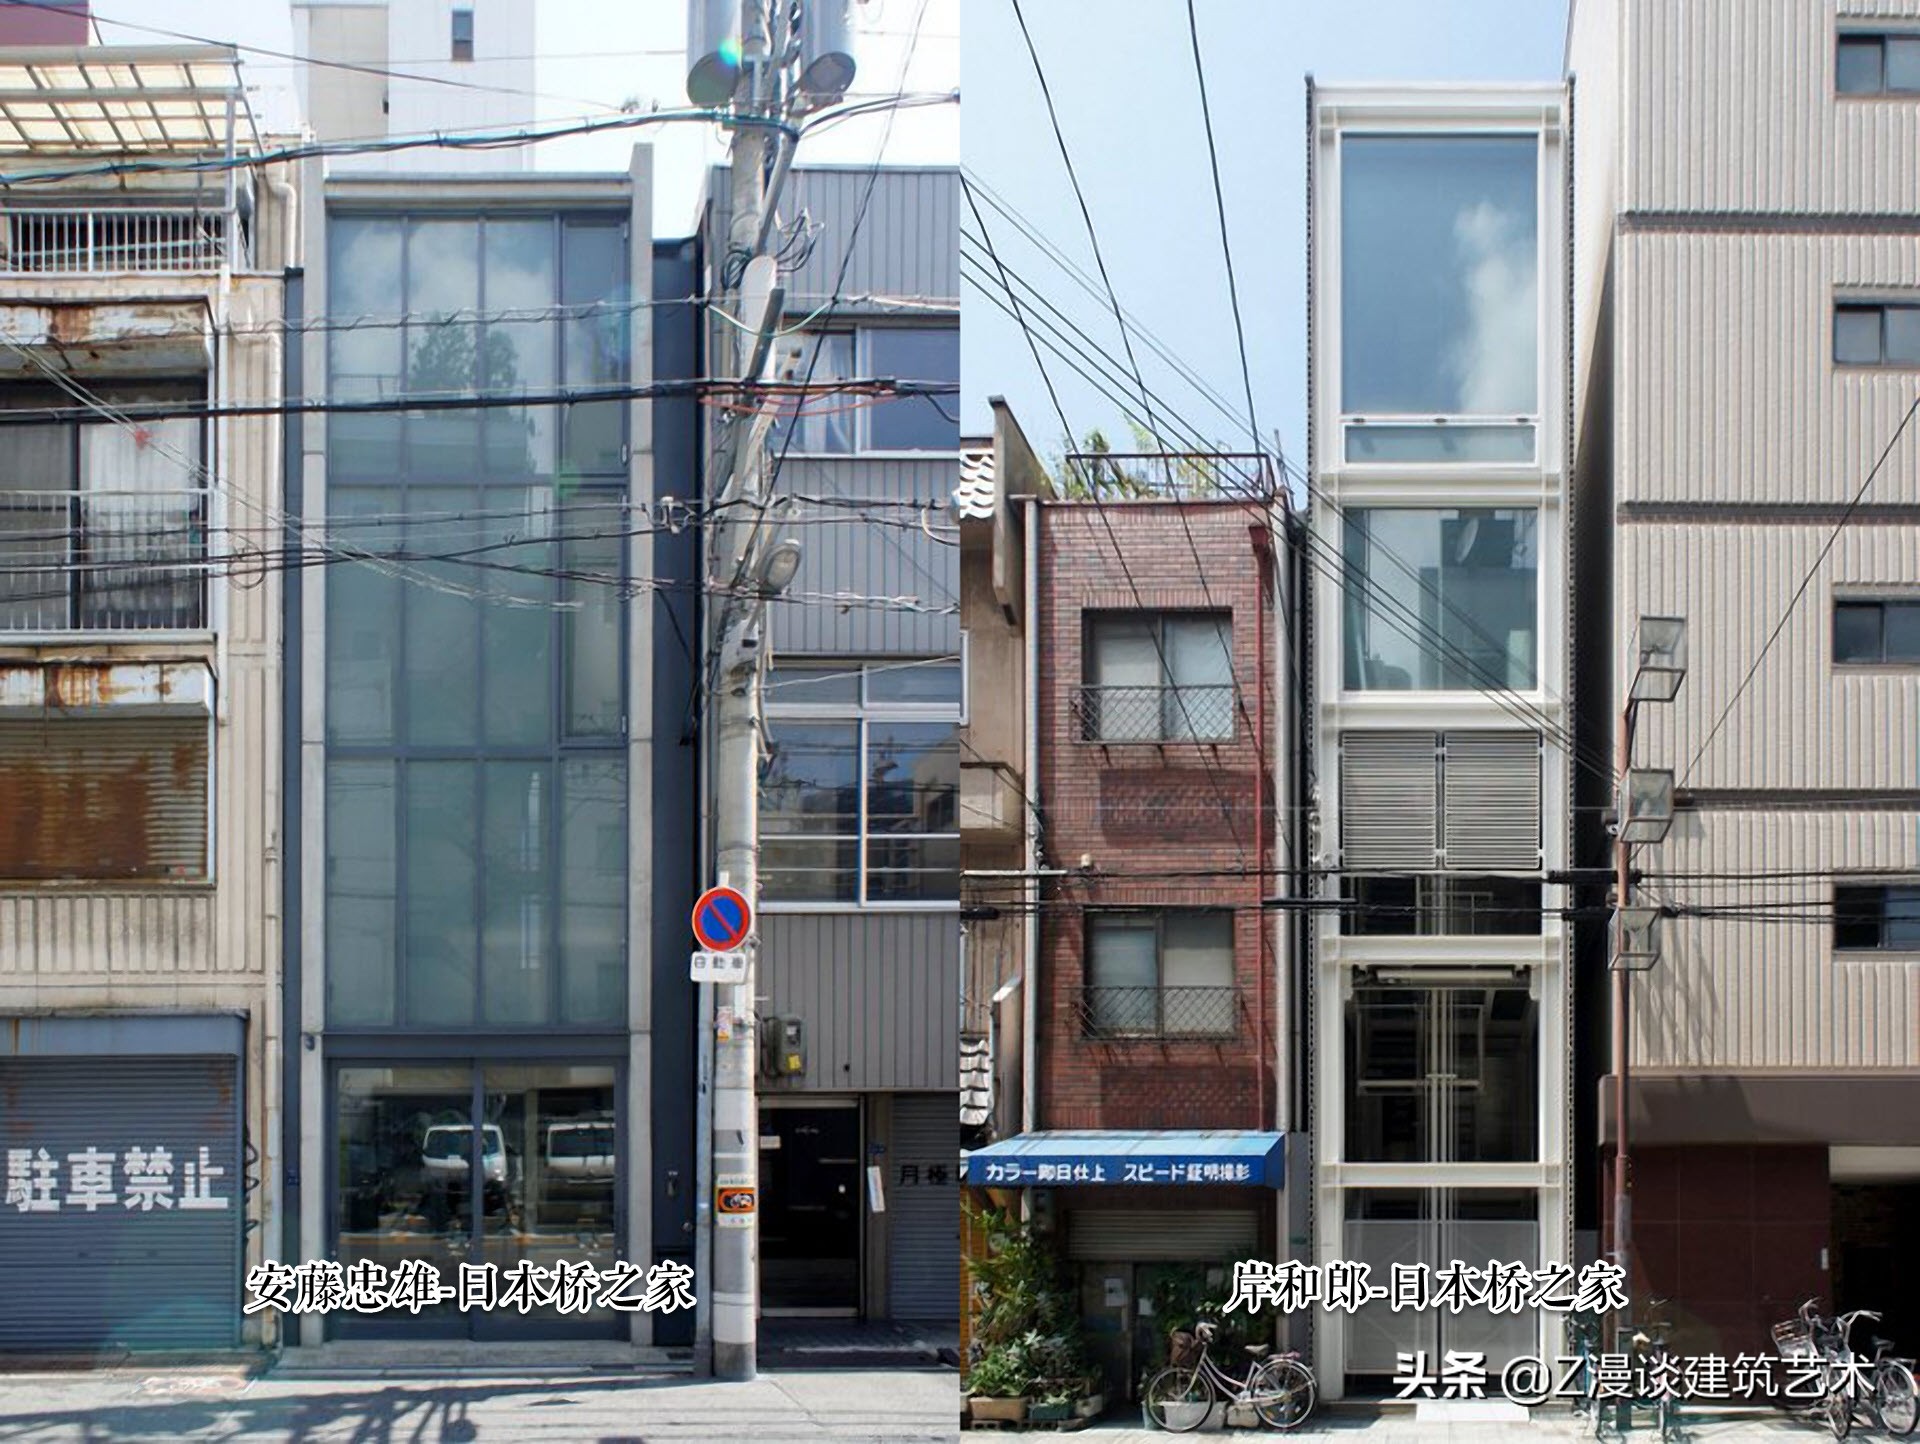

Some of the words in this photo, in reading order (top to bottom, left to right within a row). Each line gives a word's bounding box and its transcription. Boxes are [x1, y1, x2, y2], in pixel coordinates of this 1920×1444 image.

[5, 1145, 229, 1213] 駐車禁止
[900, 1164, 960, 1186] 月極
